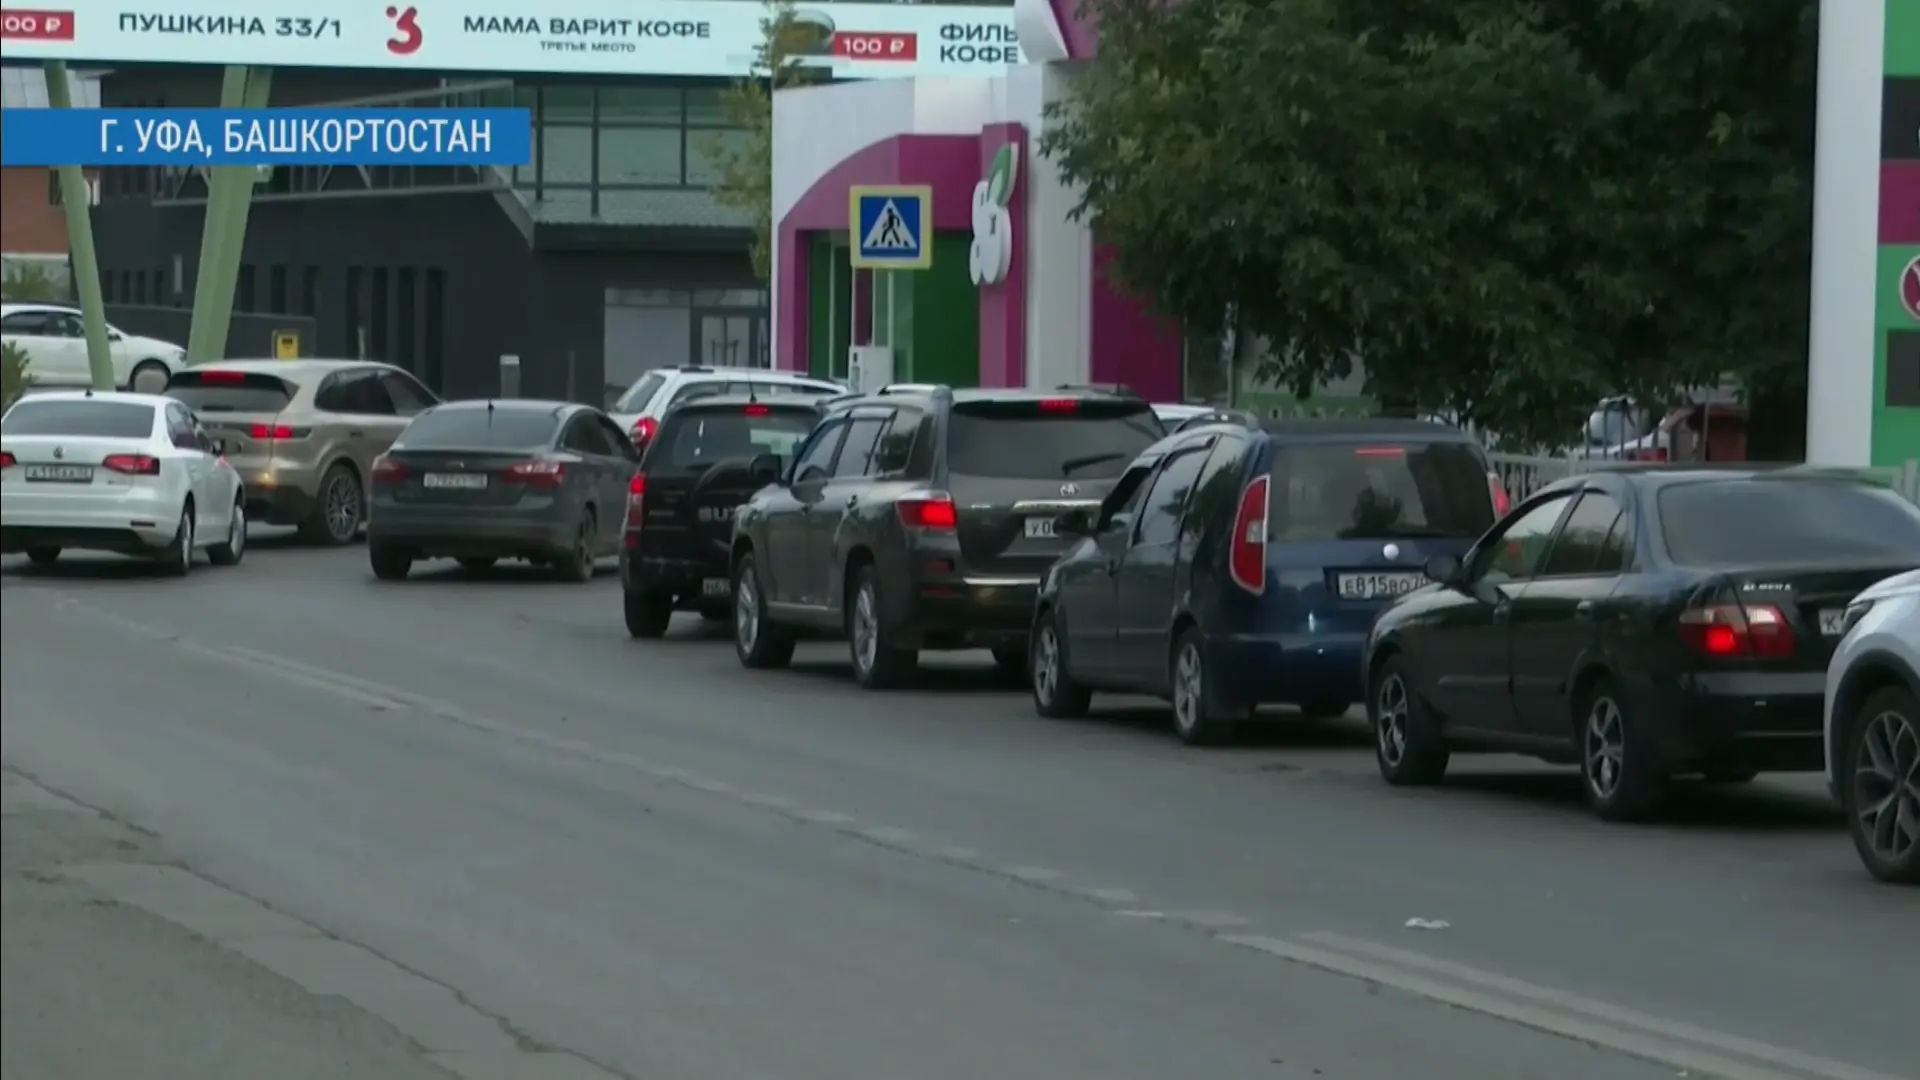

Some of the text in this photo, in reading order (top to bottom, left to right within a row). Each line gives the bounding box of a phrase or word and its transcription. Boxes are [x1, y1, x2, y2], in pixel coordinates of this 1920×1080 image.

[119, 13, 341, 39] ПУШКИНА 33/1
[464, 17, 711, 39] МАМА ВАРИТ КОФЕ
[540, 41, 587, 52] ТРЕТЬЕ
[843, 38, 881, 54] 100
[940, 45, 1019, 64] КОФЕ
